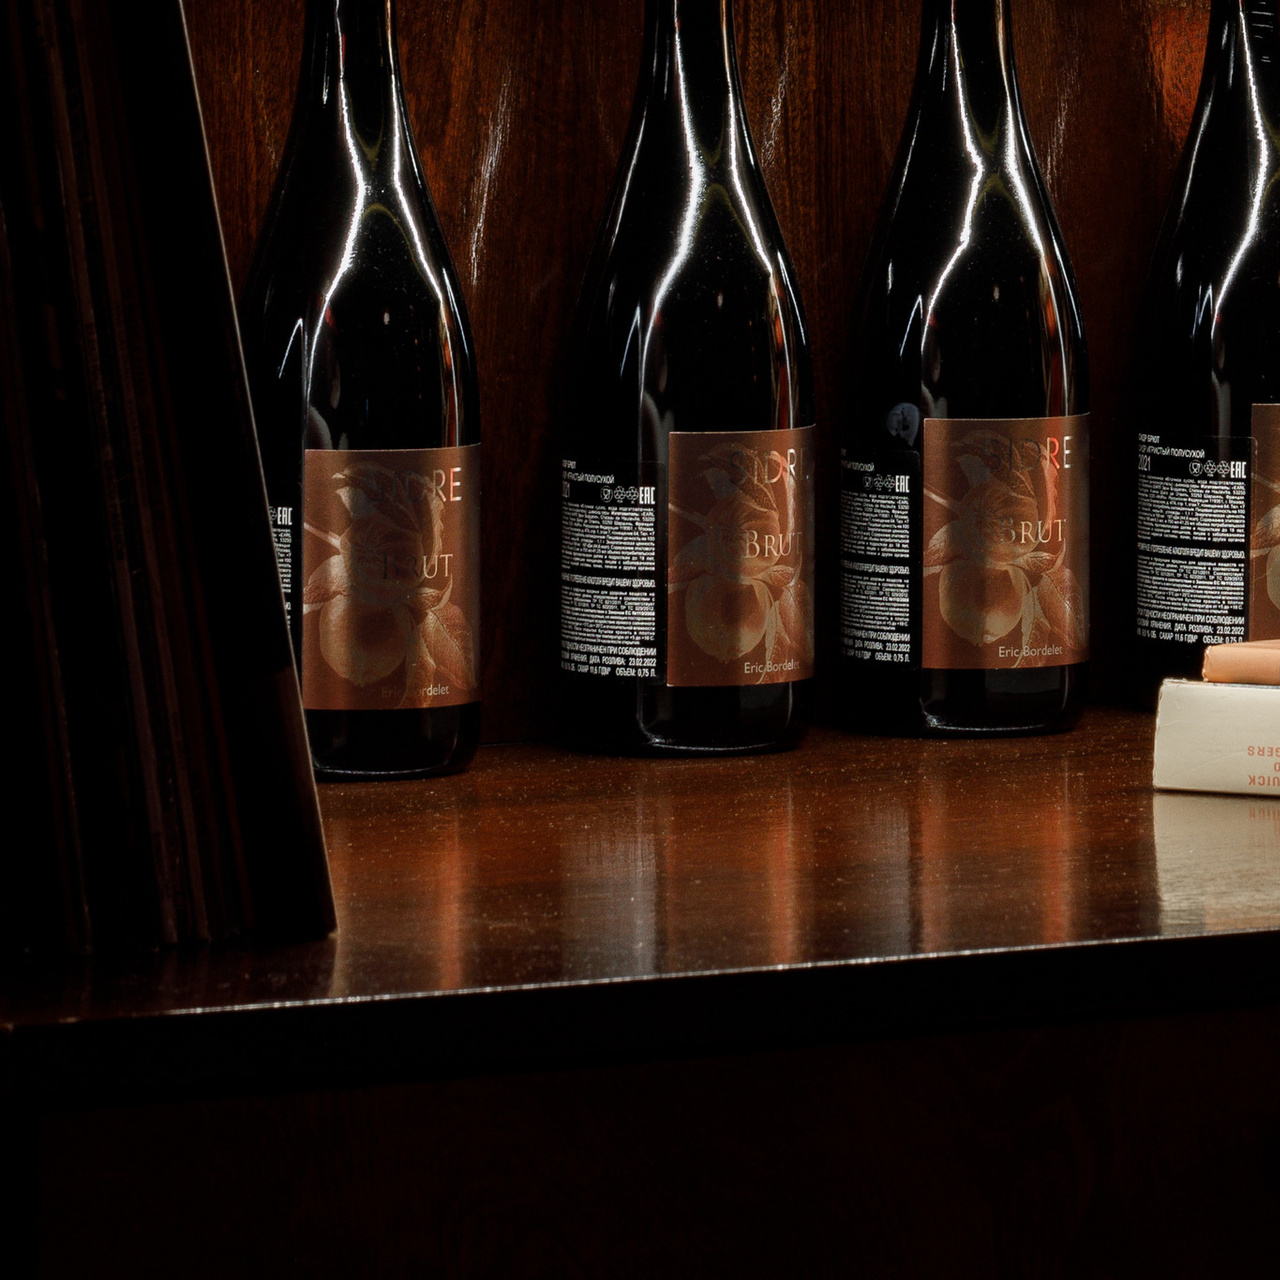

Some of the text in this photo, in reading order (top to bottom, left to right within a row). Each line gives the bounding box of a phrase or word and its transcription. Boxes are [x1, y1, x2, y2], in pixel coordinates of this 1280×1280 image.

[1216, 626, 1245, 635] 23.02.2022
[998, 644, 1063, 658] Eric Bordelet
[744, 661, 765, 675] Eric
